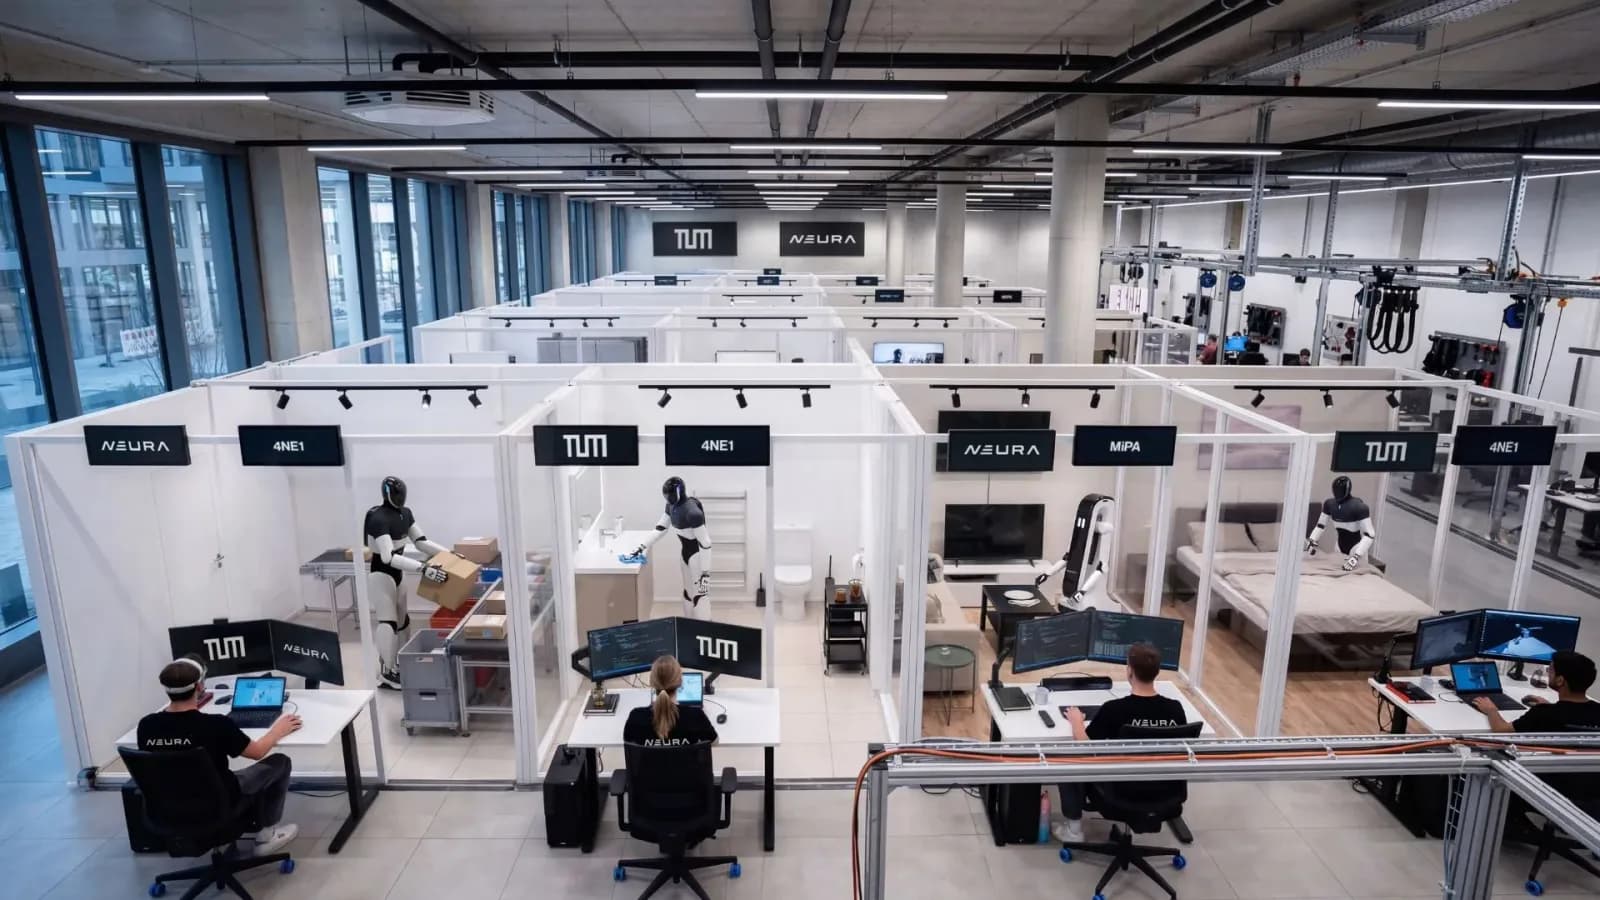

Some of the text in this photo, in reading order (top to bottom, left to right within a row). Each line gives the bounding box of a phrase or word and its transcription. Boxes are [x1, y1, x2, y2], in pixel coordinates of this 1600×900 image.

[673, 228, 713, 250] TUM
[789, 234, 857, 244] NEURA
[101, 440, 170, 452] NEURA
[273, 440, 305, 452] 4NE1
[562, 434, 608, 458] TUM
[701, 439, 734, 452] 4NE1
[964, 444, 1040, 456] NEURA
[1109, 440, 1141, 453] MiPA
[1365, 441, 1408, 462] TUM
[1489, 441, 1519, 453] 4NE1
[203, 635, 246, 661] TUM
[283, 643, 329, 661] NEURA
[695, 635, 738, 662] TUM
[1131, 718, 1178, 727] NEURA
[146, 738, 192, 746] NEURA
[644, 738, 690, 747] NEURA
